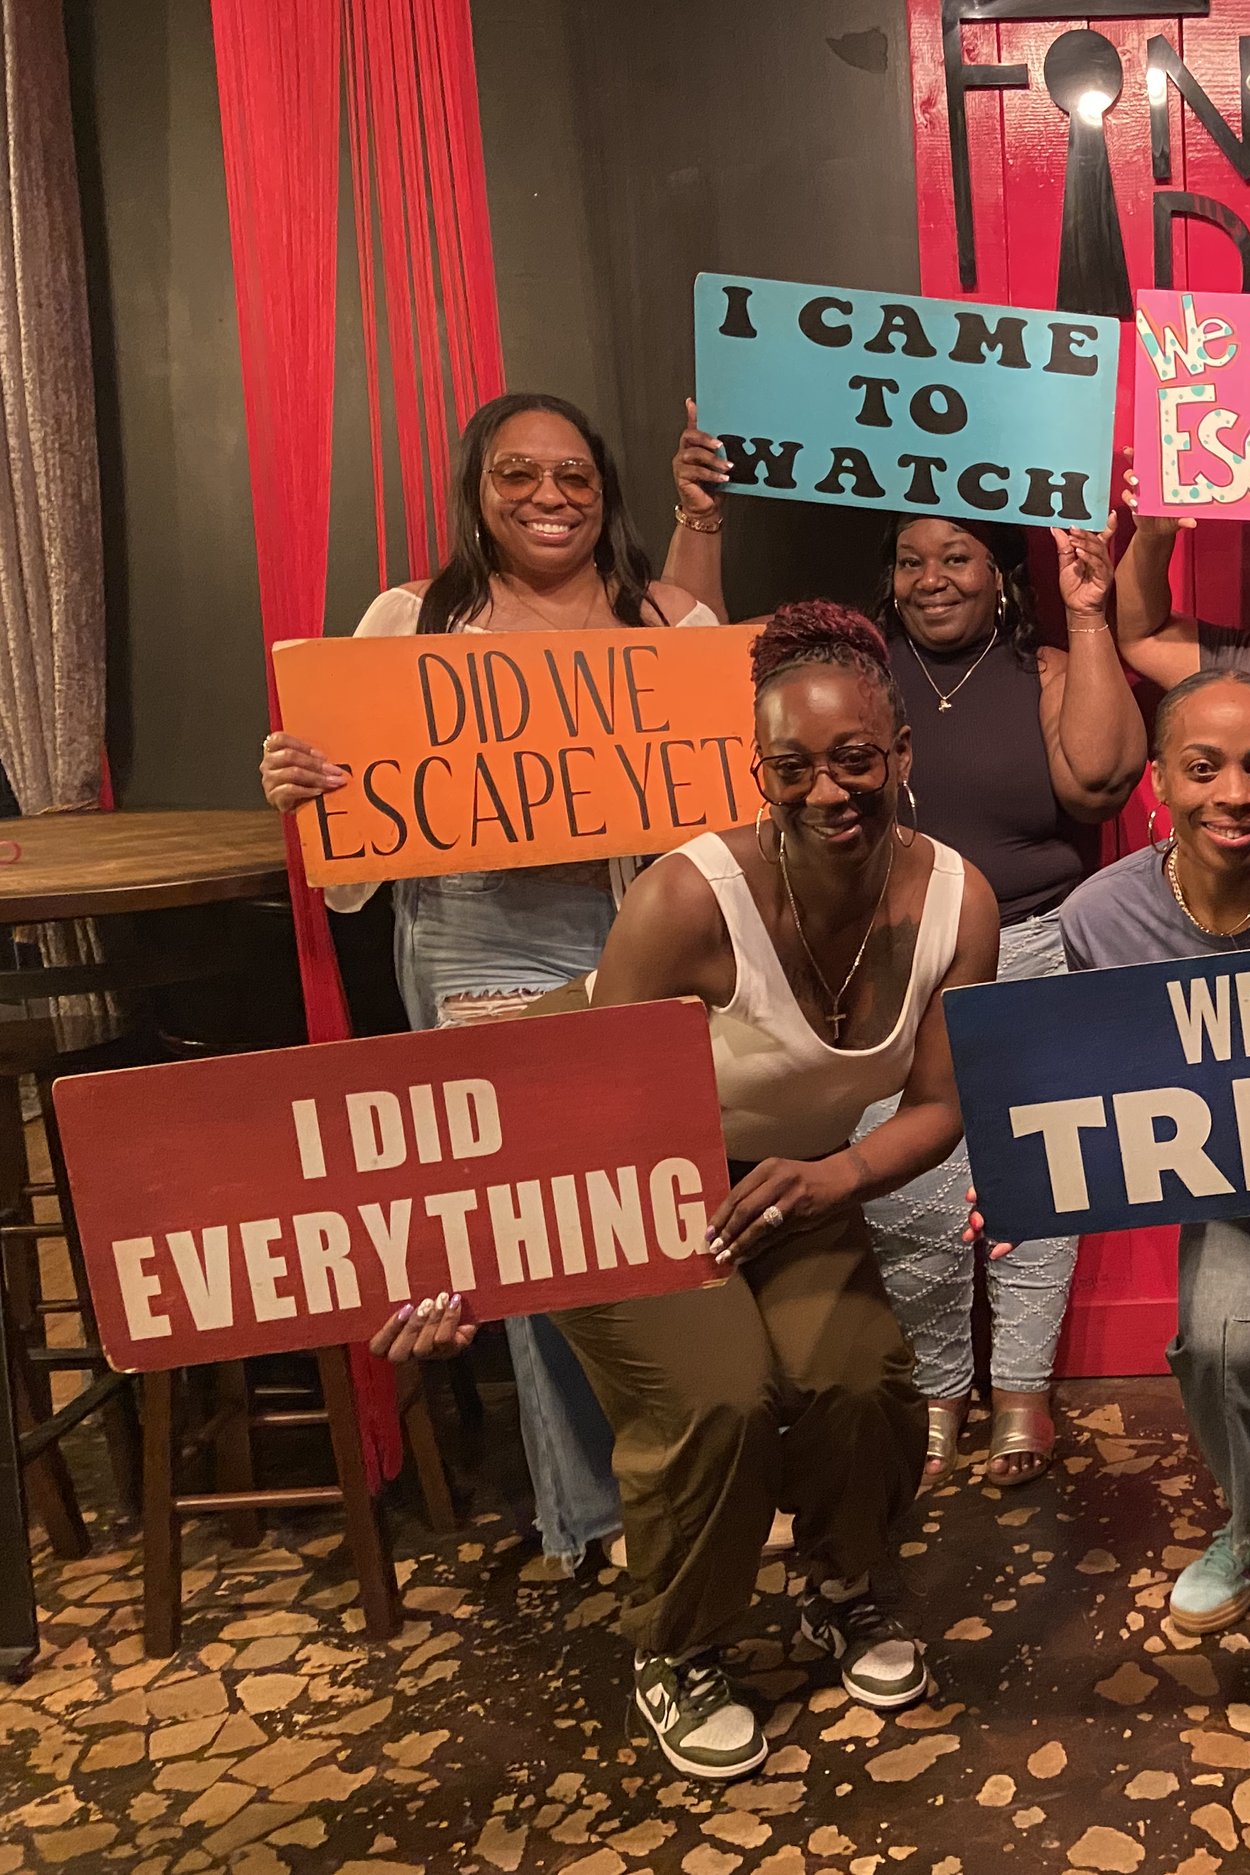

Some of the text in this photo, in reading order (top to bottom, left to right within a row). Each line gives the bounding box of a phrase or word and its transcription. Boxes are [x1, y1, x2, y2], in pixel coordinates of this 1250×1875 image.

[718, 286, 1099, 376] I CAME
[1136, 293, 1239, 382] We
[848, 375, 969, 435] TO
[717, 434, 1093, 521] WATCH
[416, 645, 670, 748] DID WE
[313, 746, 608, 862] ESCAPE
[291, 1077, 504, 1180] I DID
[111, 1157, 710, 1342] EVERYTHING
